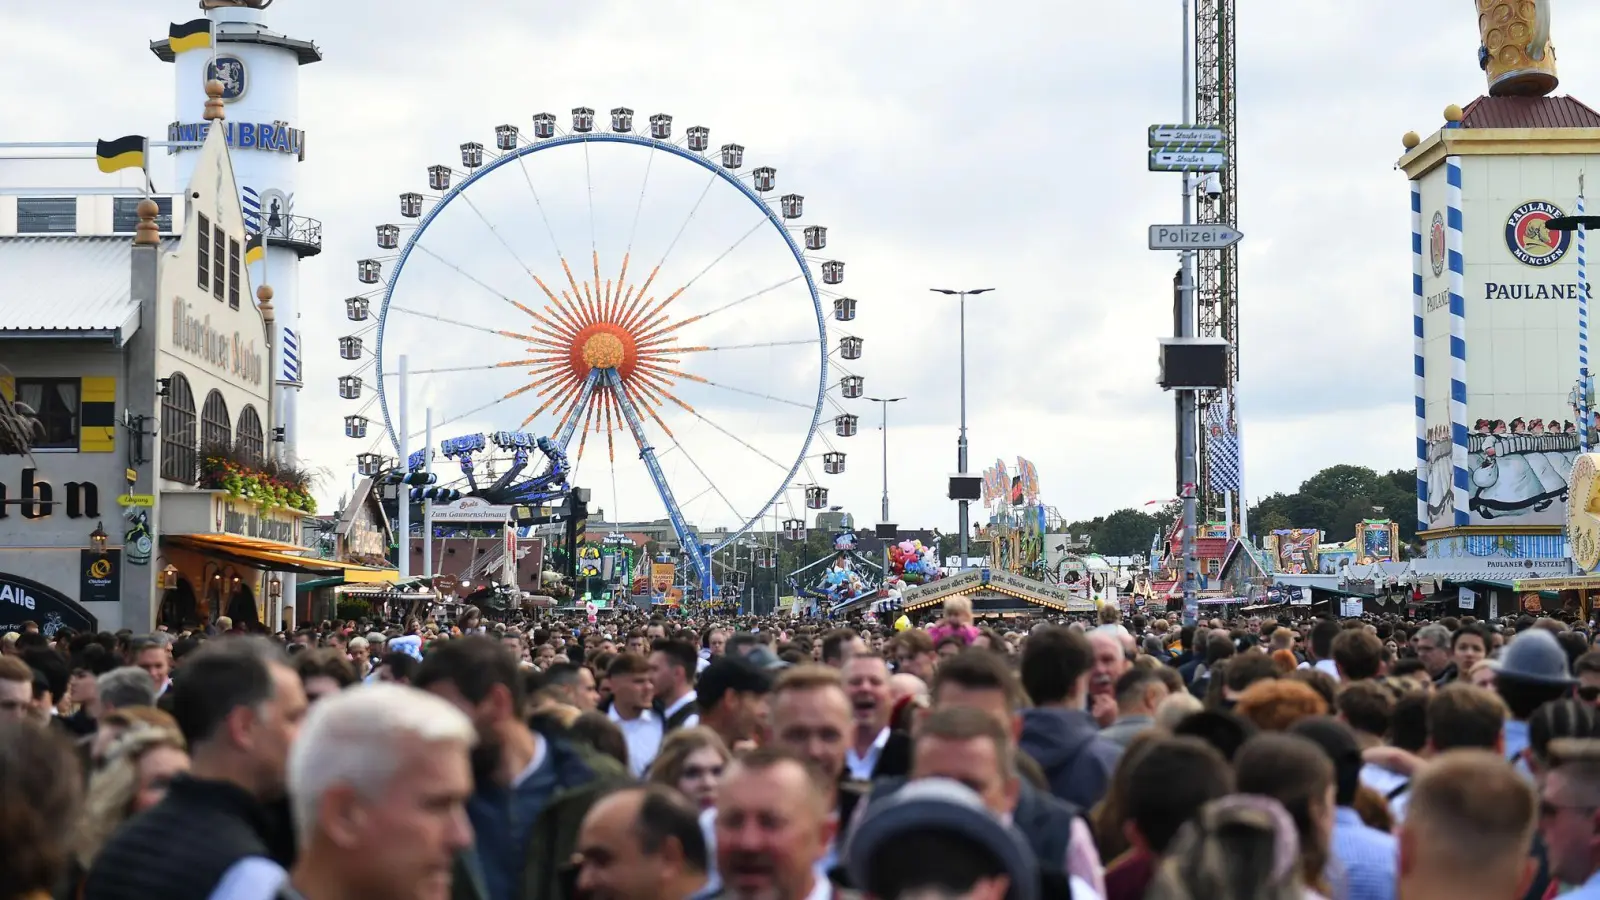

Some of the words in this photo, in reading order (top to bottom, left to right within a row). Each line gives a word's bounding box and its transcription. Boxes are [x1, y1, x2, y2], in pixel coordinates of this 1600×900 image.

[1507, 202, 1565, 227] PAULANE
[1158, 228, 1216, 243] Polizei
[1513, 248, 1564, 265] MÜNCHEN
[1487, 560, 1522, 568] PAULANER
[1534, 560, 1566, 568] FESTZELT
[0, 584, 36, 610] Alle
